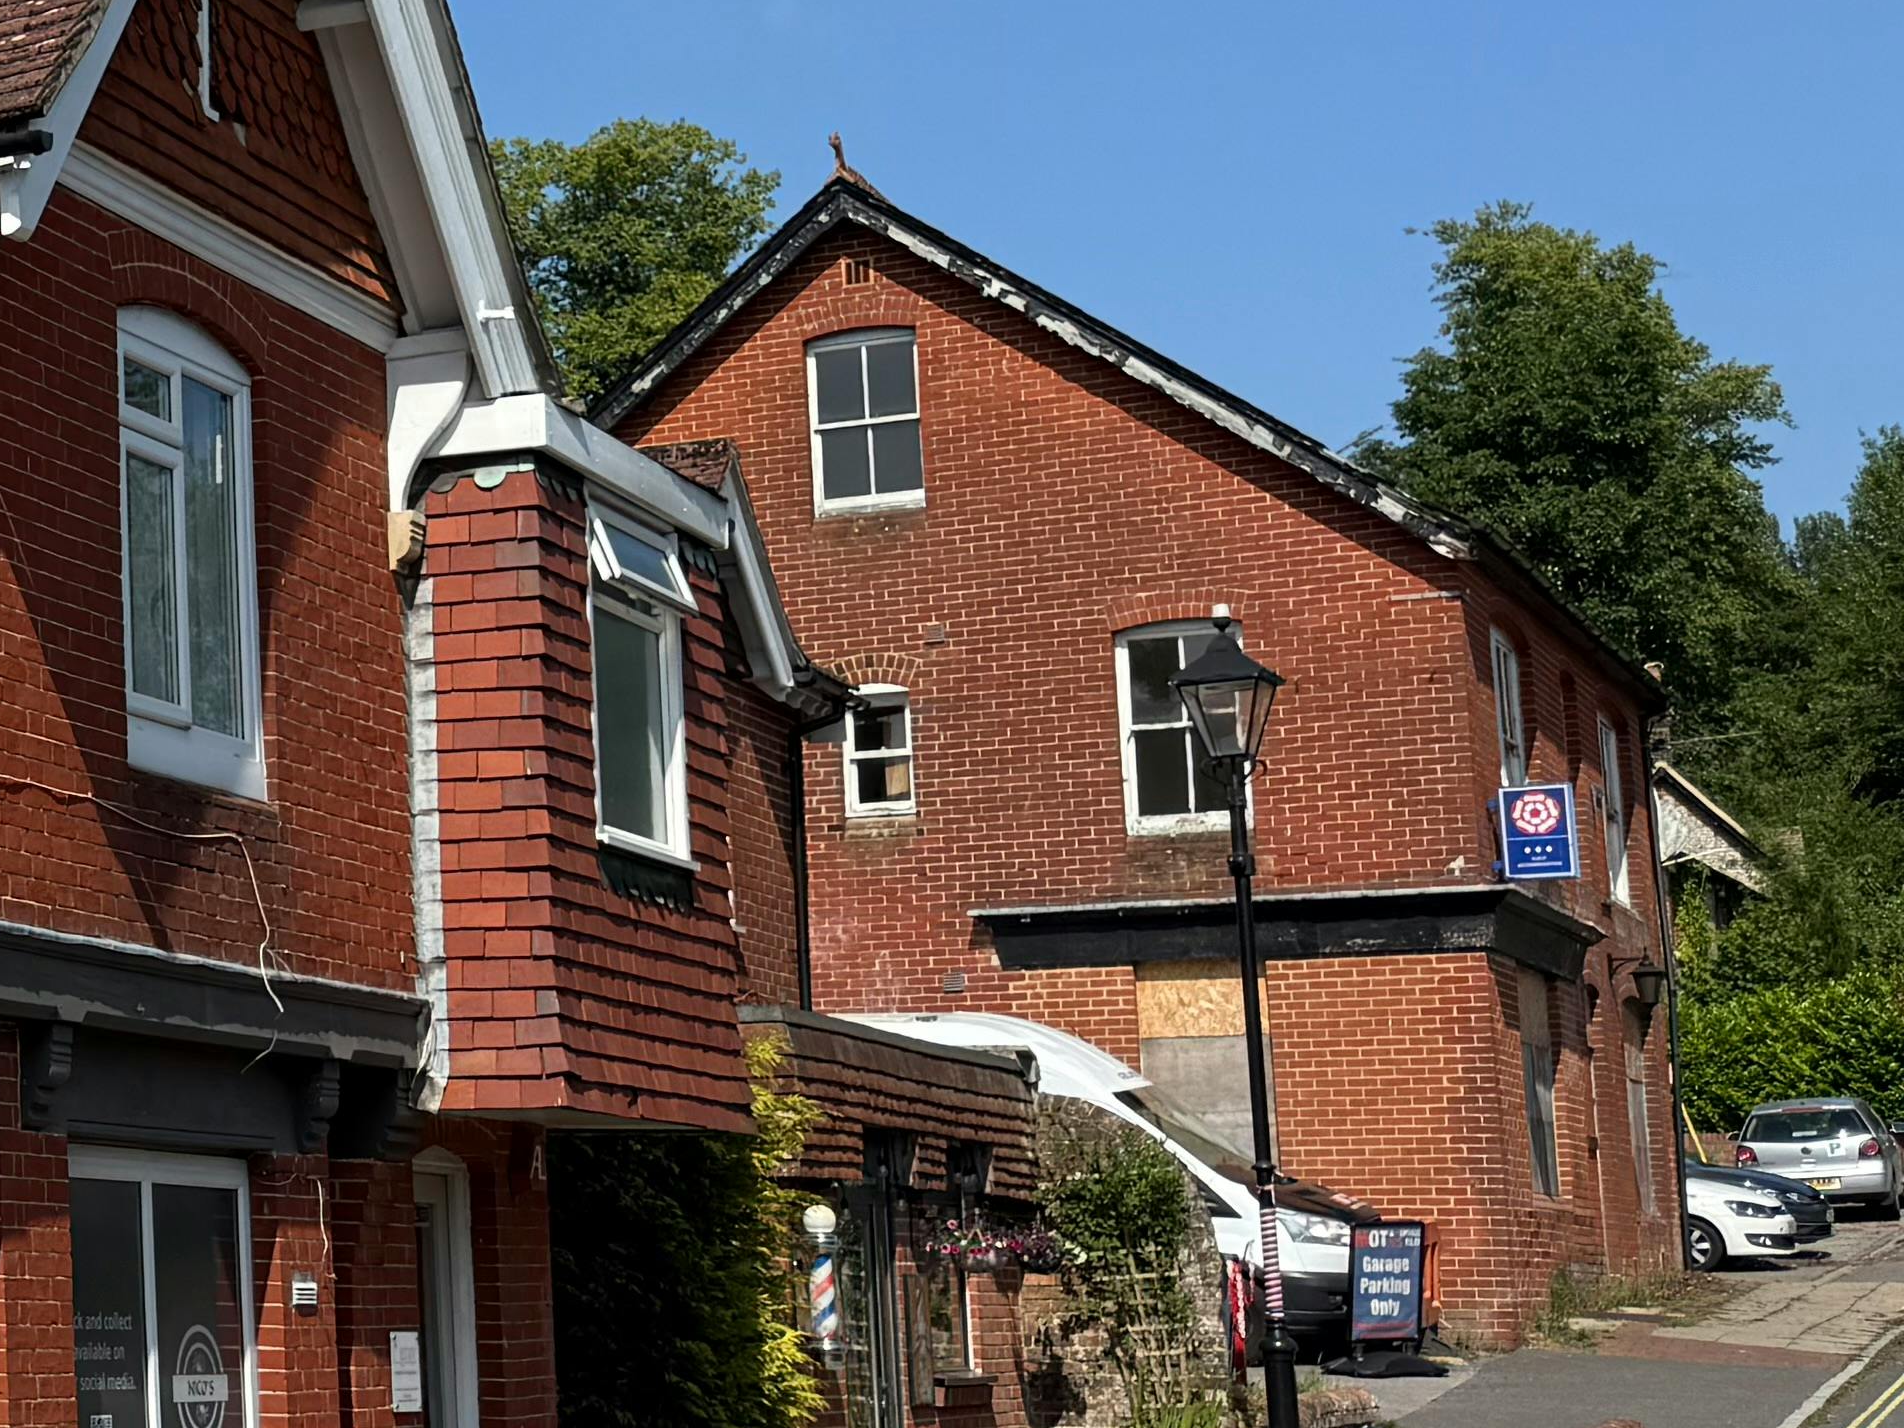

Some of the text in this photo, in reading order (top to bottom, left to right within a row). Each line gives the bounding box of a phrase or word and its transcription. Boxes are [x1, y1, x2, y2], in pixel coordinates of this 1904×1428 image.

[1362, 1255, 1410, 1274] Garage
[1360, 1276, 1411, 1295] Parking
[1370, 1298, 1401, 1317] Only
[104, 1311, 132, 1330] collect
